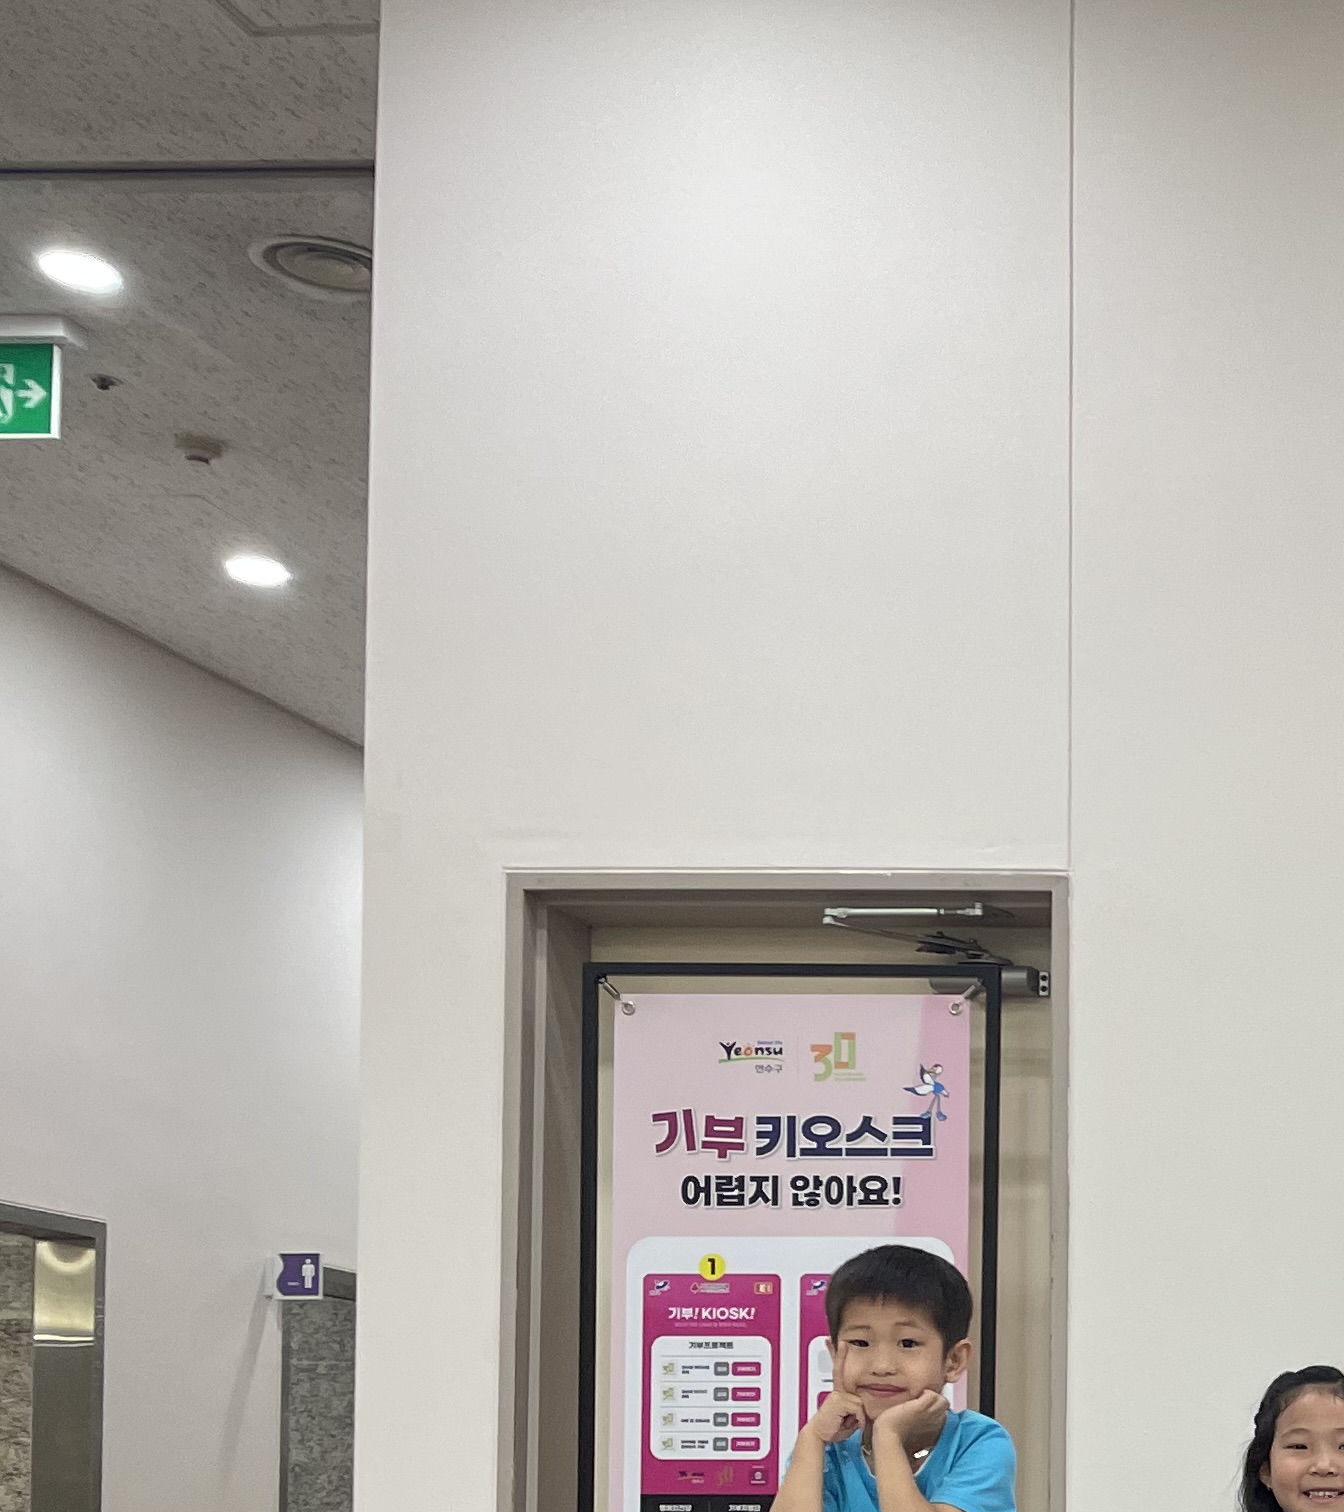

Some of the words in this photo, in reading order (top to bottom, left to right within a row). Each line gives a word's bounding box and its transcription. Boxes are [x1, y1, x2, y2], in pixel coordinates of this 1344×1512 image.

[719, 1041, 783, 1060] Yeonsu
[810, 1032, 856, 1081] 30
[755, 1064, 783, 1073] 연수구
[652, 1109, 745, 1159] 기부
[755, 1115, 934, 1158] 키오스크
[680, 1175, 780, 1209] 어렵지
[790, 1174, 902, 1207] 않아요!
[706, 1258, 718, 1276] 1
[668, 1307, 699, 1320] 기부!
[701, 1307, 756, 1320] KIOSK!
